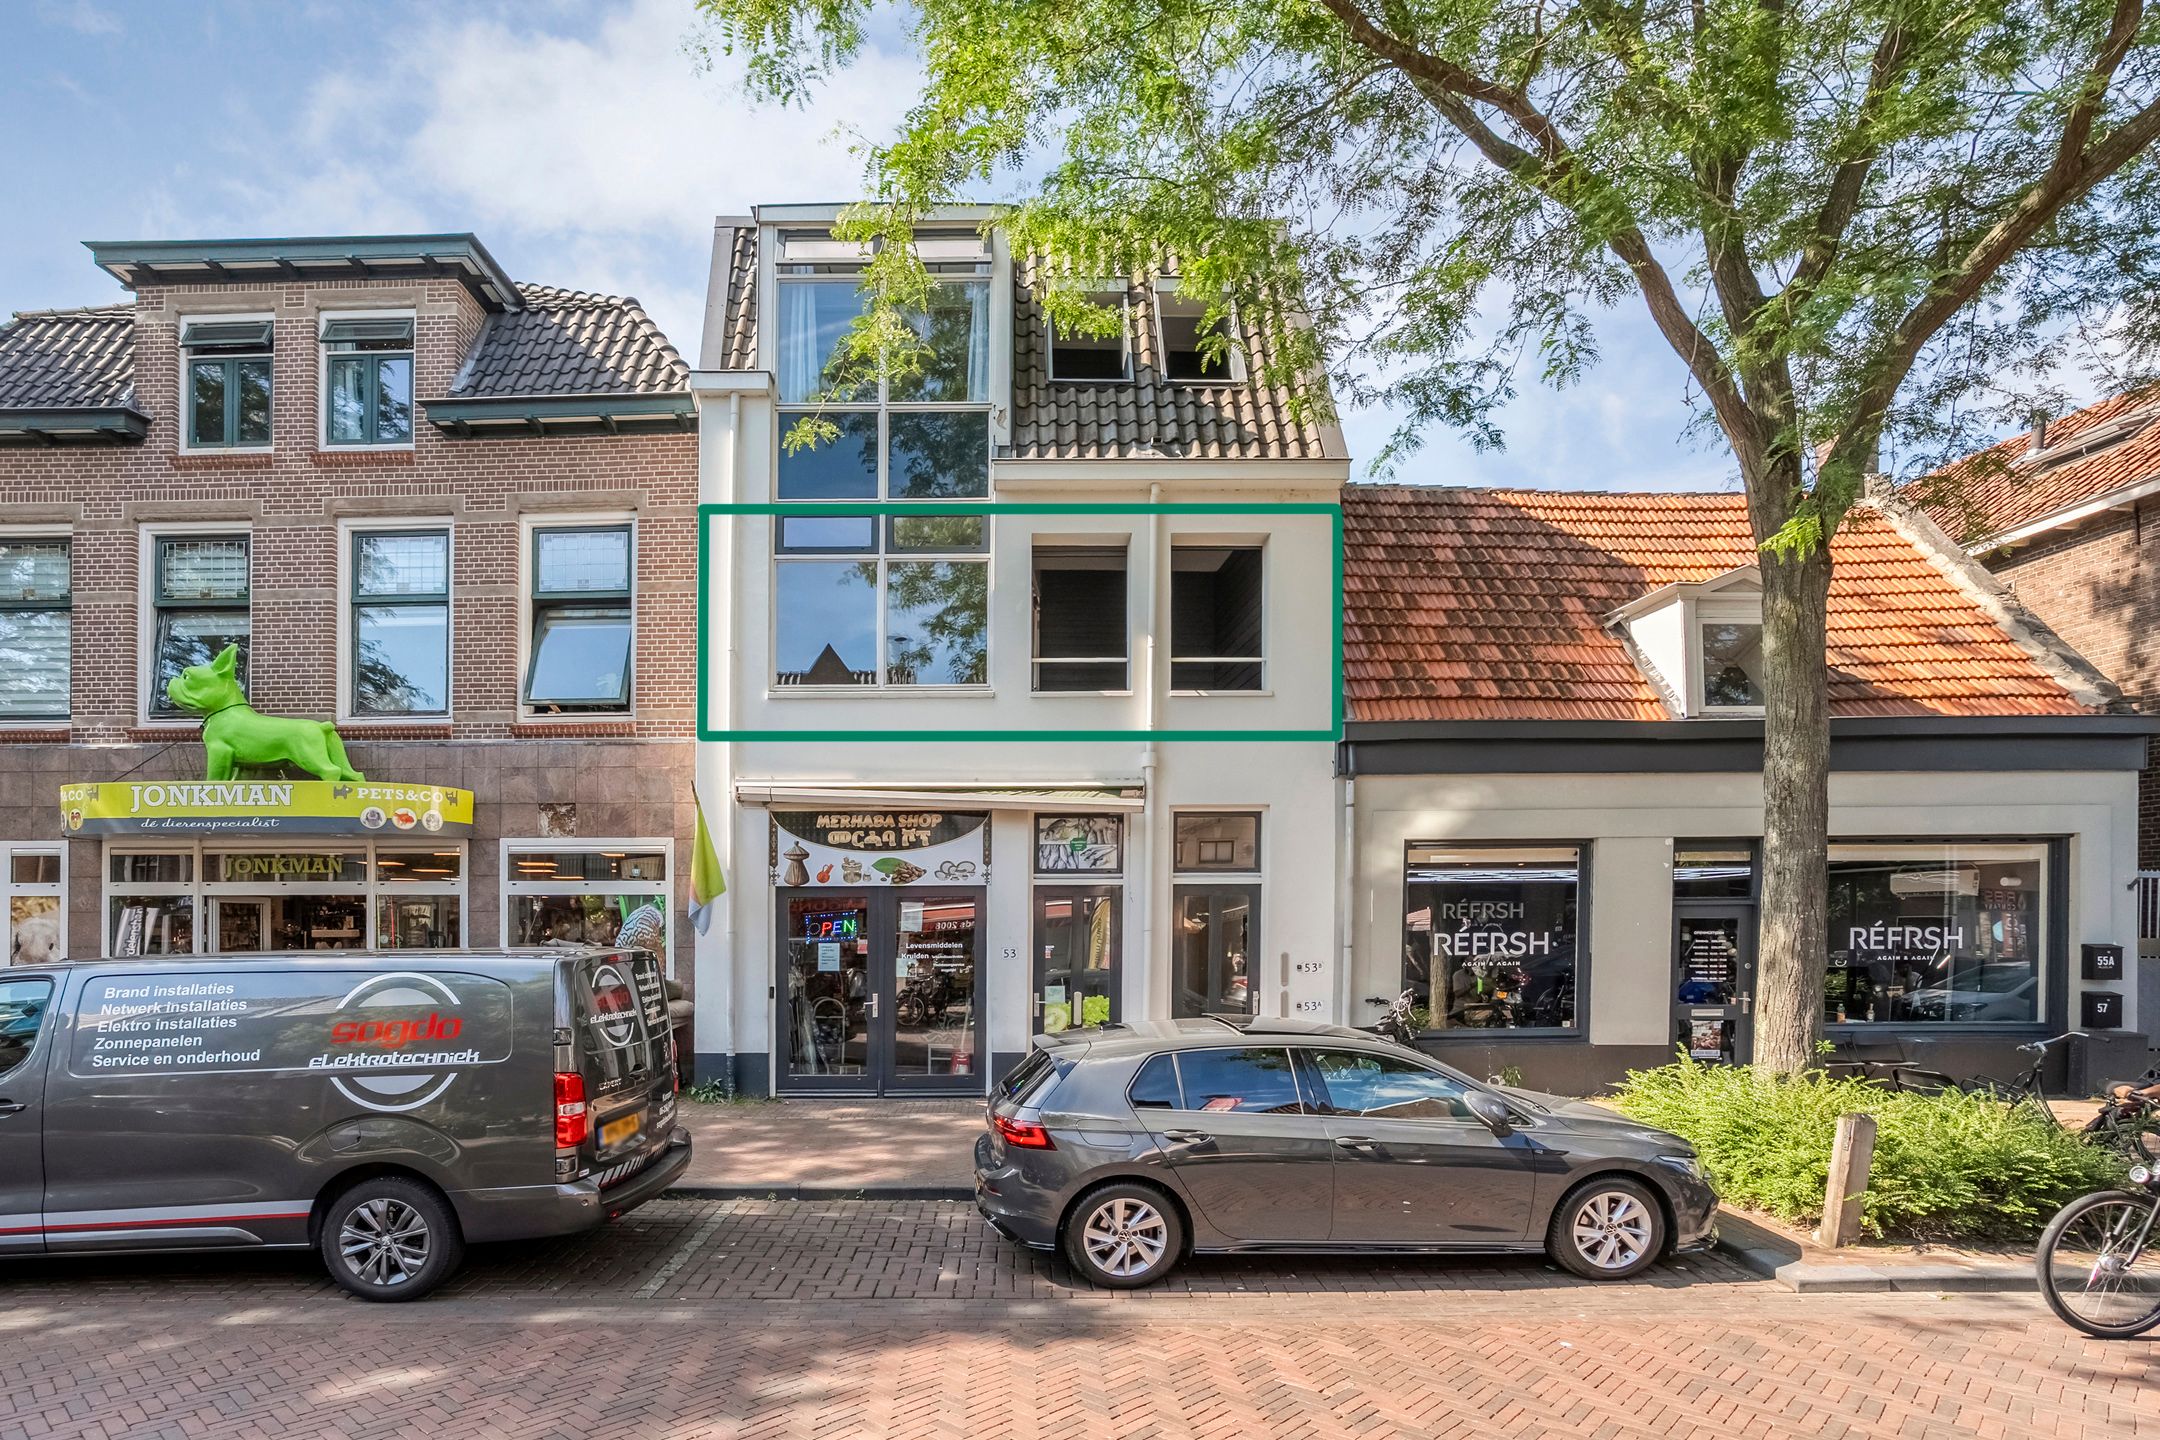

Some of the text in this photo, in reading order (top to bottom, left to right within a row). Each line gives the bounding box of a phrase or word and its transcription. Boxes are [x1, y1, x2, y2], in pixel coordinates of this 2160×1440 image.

[130, 783, 294, 813] JONKMAN
[357, 786, 444, 804] PETS&CO
[161, 817, 280, 832] dierenspecialist
[816, 813, 943, 829] MERHABA SHOP
[224, 857, 344, 879] JONKMAN
[1443, 898, 1525, 920] RÉFRSH
[808, 919, 855, 937] OPEN
[1849, 919, 1963, 950] RÉFRSH
[905, 941, 963, 949] Levensmiddelen
[1433, 924, 1549, 956] RÉFRSH
[901, 952, 929, 960] Kruiden
[1003, 948, 1017, 959] 53
[2097, 956, 2115, 966] 55A
[104, 982, 234, 999] Brand installaties
[101, 998, 247, 1016] Netwerk installaties
[2097, 1003, 2108, 1013] 57
[97, 1016, 237, 1033] Elektro installaties
[330, 1012, 465, 1049] sogdo
[94, 1035, 203, 1052] Zonnepanelen
[92, 1049, 261, 1068] Service en onderhoud
